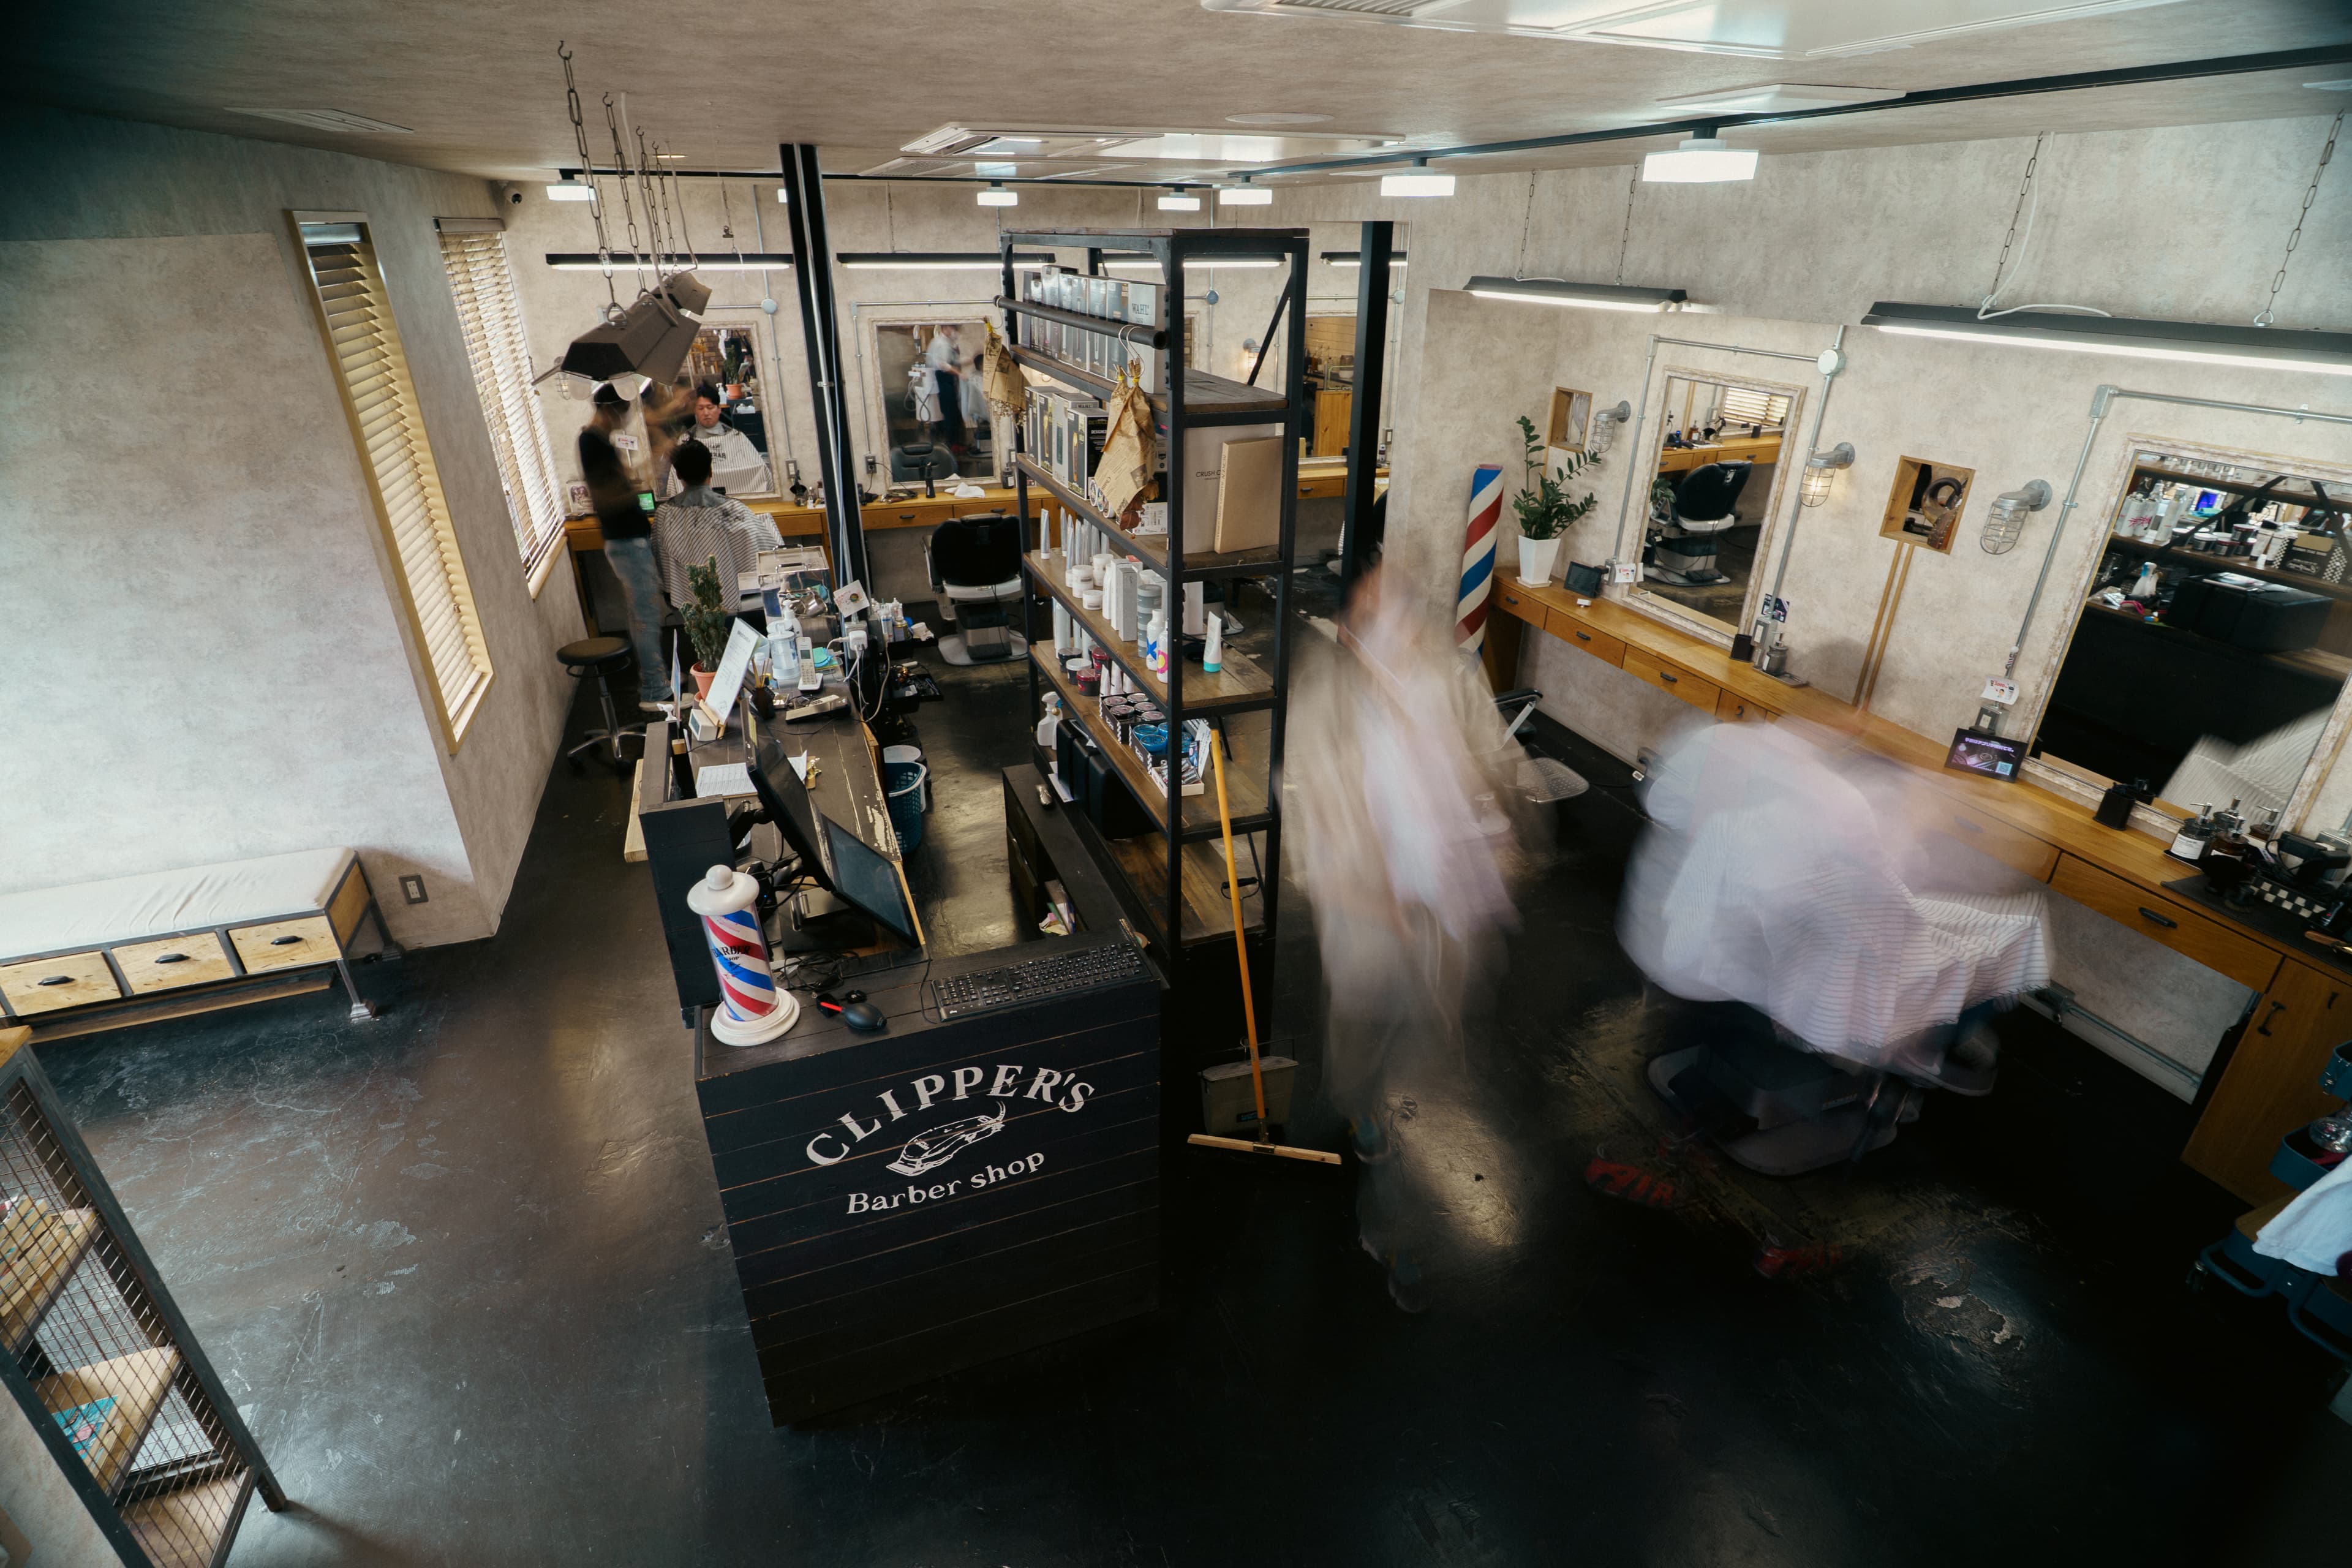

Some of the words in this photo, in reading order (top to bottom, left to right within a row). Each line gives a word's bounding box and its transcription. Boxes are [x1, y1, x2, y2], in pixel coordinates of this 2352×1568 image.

[1131, 303, 1150, 315] WAHL
[710, 945, 751, 958] BARBER
[806, 1065, 1095, 1166] CLIPPER'S
[846, 1180, 962, 1215] Barber
[970, 1152, 1045, 1189] shop
